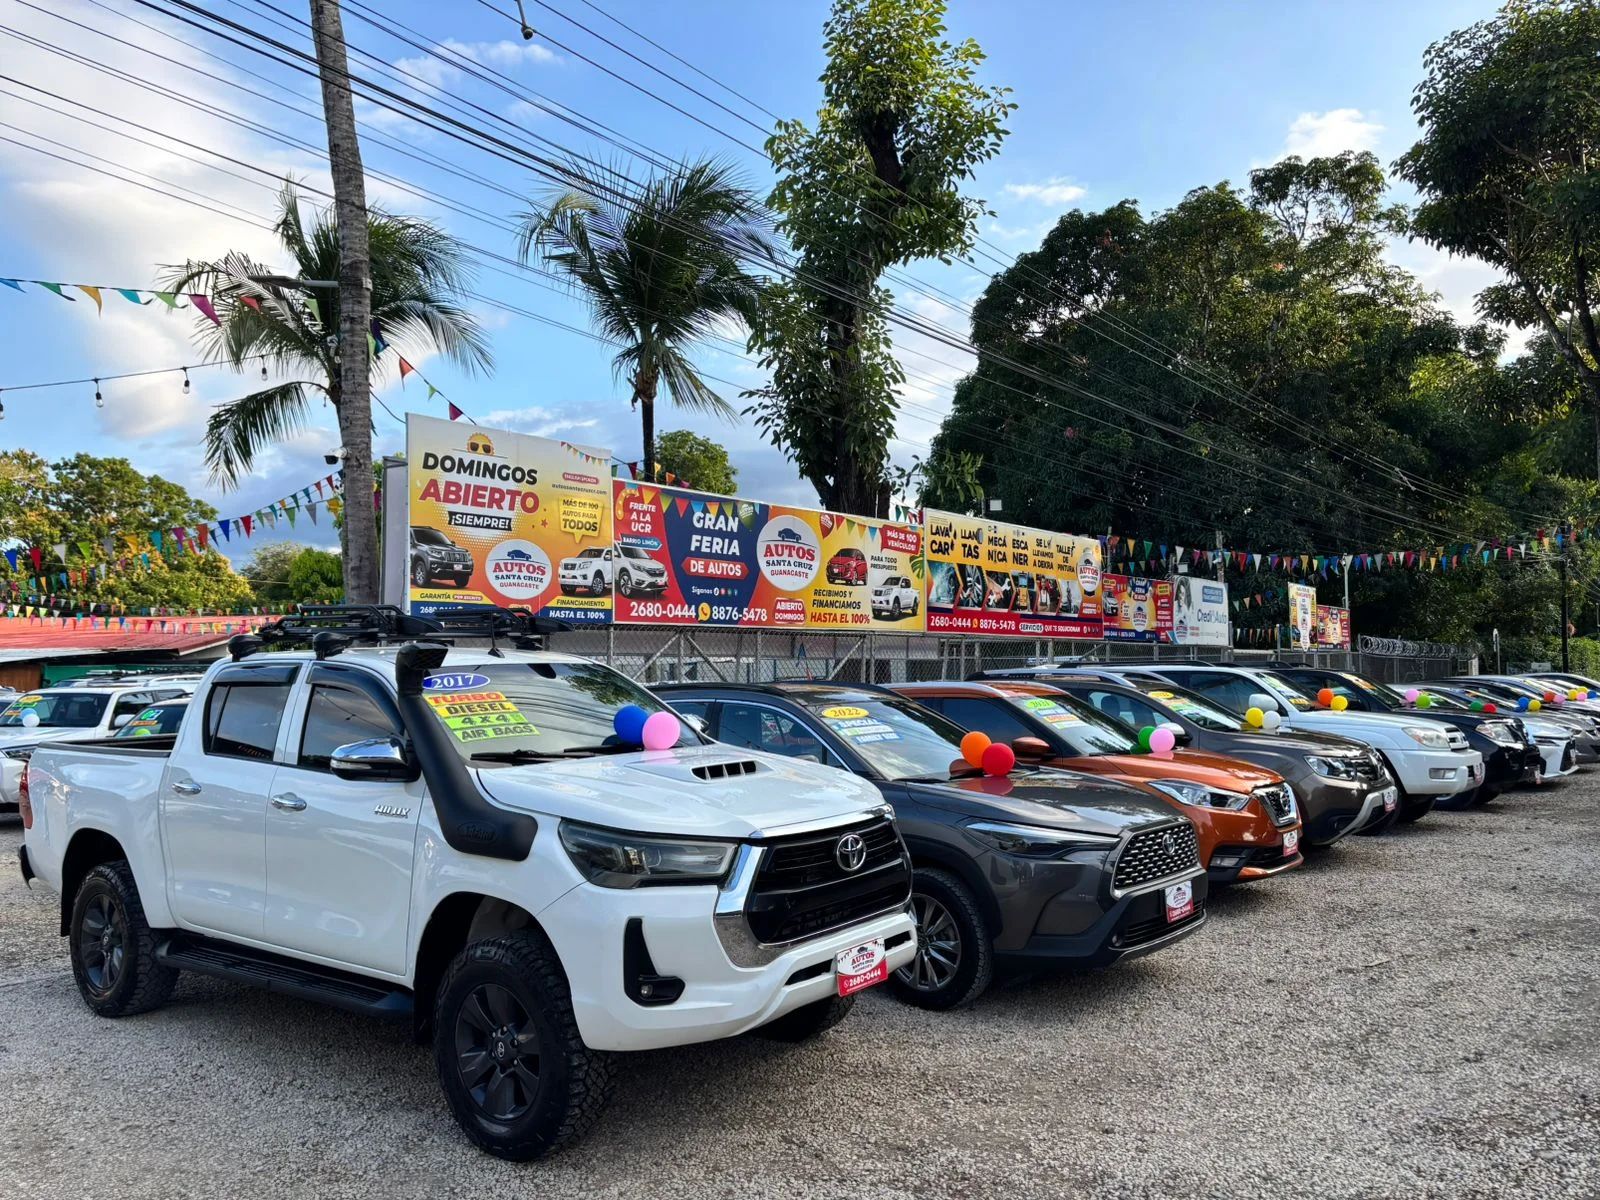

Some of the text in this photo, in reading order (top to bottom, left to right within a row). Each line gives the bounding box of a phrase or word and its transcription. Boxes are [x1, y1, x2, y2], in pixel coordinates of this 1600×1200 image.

[422, 451, 538, 485] DOMINGOS
[419, 478, 540, 514] ABIERTO
[562, 498, 599, 510] MÁS DE 100
[629, 502, 657, 512] FRENTE
[562, 509, 598, 520] AUTOS PARA
[630, 512, 652, 523] A LA
[451, 514, 510, 529] ¡SIEMPRE!
[562, 518, 598, 532] TODOS
[631, 522, 652, 533] UCR
[692, 511, 739, 533] GRAN
[899, 532, 907, 540] DE
[906, 533, 918, 543] 100
[930, 523, 951, 539] LAVA
[623, 536, 659, 547] BARRIO LIMÓN
[690, 534, 741, 556] FERIA
[930, 539, 950, 556] CAR
[987, 535, 1008, 548] MECÁ
[1012, 538, 1029, 551] ESCA
[1035, 538, 1043, 548] SE
[763, 544, 816, 562] AUTOS
[961, 543, 980, 560] TAS
[765, 560, 813, 571] SANTA CRUZ
[870, 555, 898, 565] PARA TODO
[1012, 552, 1029, 567] NER
[1032, 559, 1037, 567] A
[492, 561, 546, 577] AUTOS
[690, 560, 742, 577] DE AUTOS
[870, 563, 898, 572] PRESUPUESTO
[1080, 566, 1099, 577] AUTOS
[494, 574, 544, 584] SANTA CRUZ
[770, 569, 809, 580] GUANACASTE
[499, 581, 540, 590] GUANACASTE
[420, 592, 451, 600] GARANTÍA
[813, 588, 853, 598] RECIBIMOS Y
[556, 599, 606, 608] FINANCIAMIENTO
[630, 601, 697, 619] 2680-0444
[776, 600, 803, 611] ABIERTO
[812, 599, 862, 610] FINANCIAMOS
[549, 609, 606, 619] HASTA EL 100%
[712, 606, 768, 622] 8876-5478
[774, 612, 805, 621] DOMINGOS
[810, 612, 871, 625] HASTA EL 100%
[930, 615, 1016, 631] 2680-0444 8876-5478
[431, 674, 475, 690] 2017
[429, 692, 504, 705] TURBO
[445, 702, 511, 716] DIESEL
[830, 707, 861, 718] 2022
[461, 725, 534, 741] AIR BAGS
[851, 951, 876, 966] AUTOS
[849, 968, 882, 987] 2680-0444
